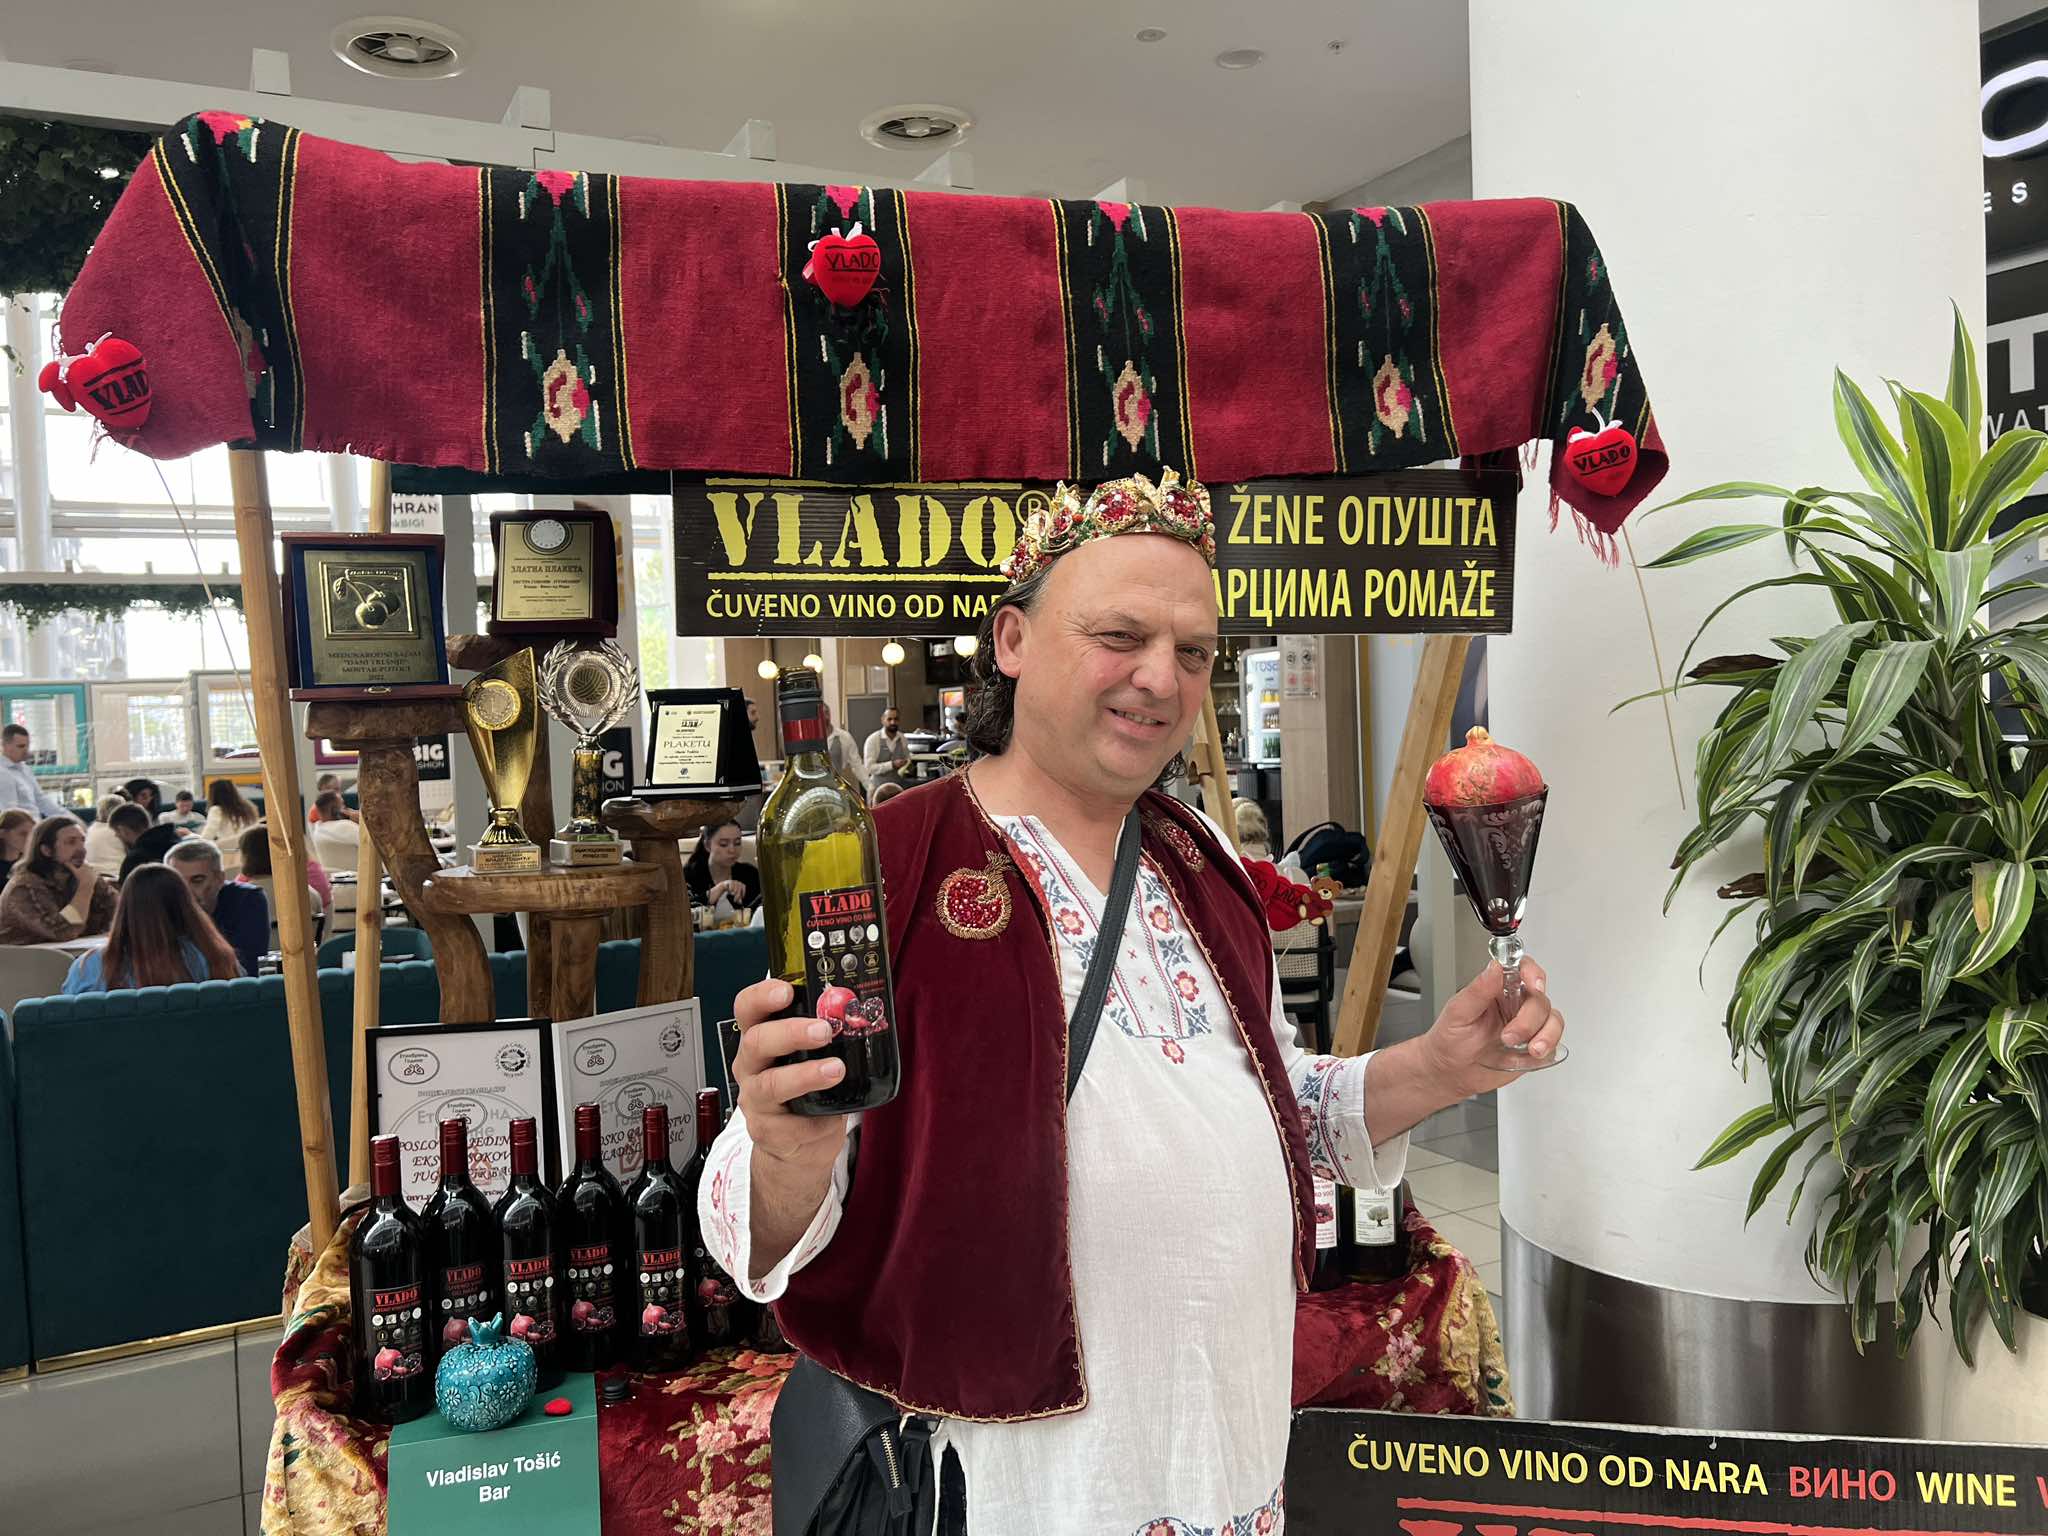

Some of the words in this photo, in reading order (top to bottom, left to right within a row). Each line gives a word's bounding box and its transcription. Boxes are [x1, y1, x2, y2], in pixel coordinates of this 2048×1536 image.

[824, 251, 879, 269] VLADO
[88, 368, 149, 411] VLAD
[1572, 445, 1631, 472] VLADO
[1227, 484, 1324, 545] ŽENE
[1337, 496, 1497, 547] ОПУШТА
[706, 589, 821, 619] ČUVENO
[830, 593, 896, 618] VINO
[904, 593, 949, 618] OD
[953, 594, 1001, 618] NA
[1211, 568, 1352, 627] РЦИМА
[1364, 560, 1496, 618] POMAŽE
[810, 892, 871, 915] VLADO
[510, 1257, 550, 1273] VLADO
[643, 1250, 681, 1265] VLADO
[447, 1267, 481, 1281] VLADO
[376, 1287, 418, 1304] VLADO
[426, 1462, 509, 1488] Vladislav
[513, 1450, 562, 1473] Tošić
[1347, 1433, 1490, 1477] ČUVENO
[1499, 1448, 1588, 1485] VINO
[1599, 1454, 1655, 1488] OD
[1664, 1459, 1770, 1496] NARA
[1788, 1465, 1897, 1502] ВИНО
[1916, 1471, 2018, 1509] WINE
[479, 1485, 511, 1502] Bar
